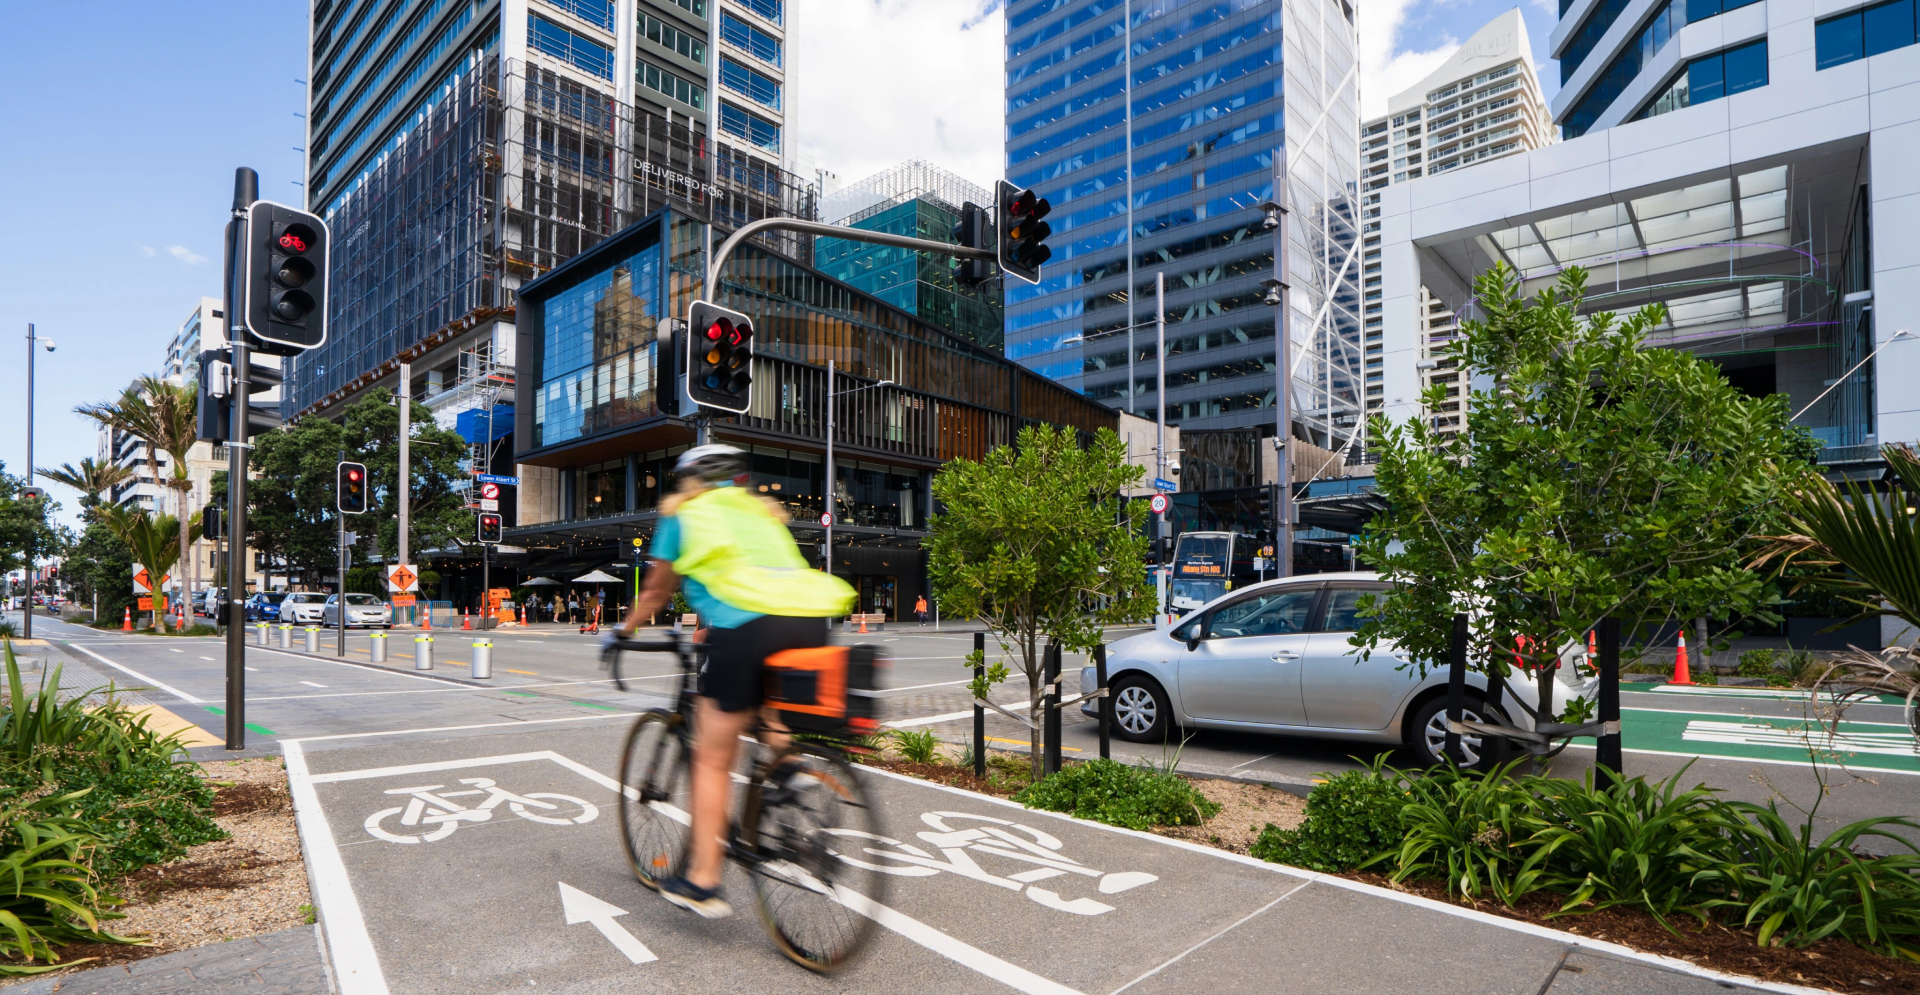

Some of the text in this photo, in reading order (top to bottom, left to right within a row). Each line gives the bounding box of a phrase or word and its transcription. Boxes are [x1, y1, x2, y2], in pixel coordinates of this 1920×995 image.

[1460, 33, 1511, 61] QUAY WEST
[634, 158, 724, 200] DELIVERED FOR
[549, 214, 586, 229] AUCKLAND
[1154, 499, 1164, 507] 20
[1263, 545, 1274, 556] 08
